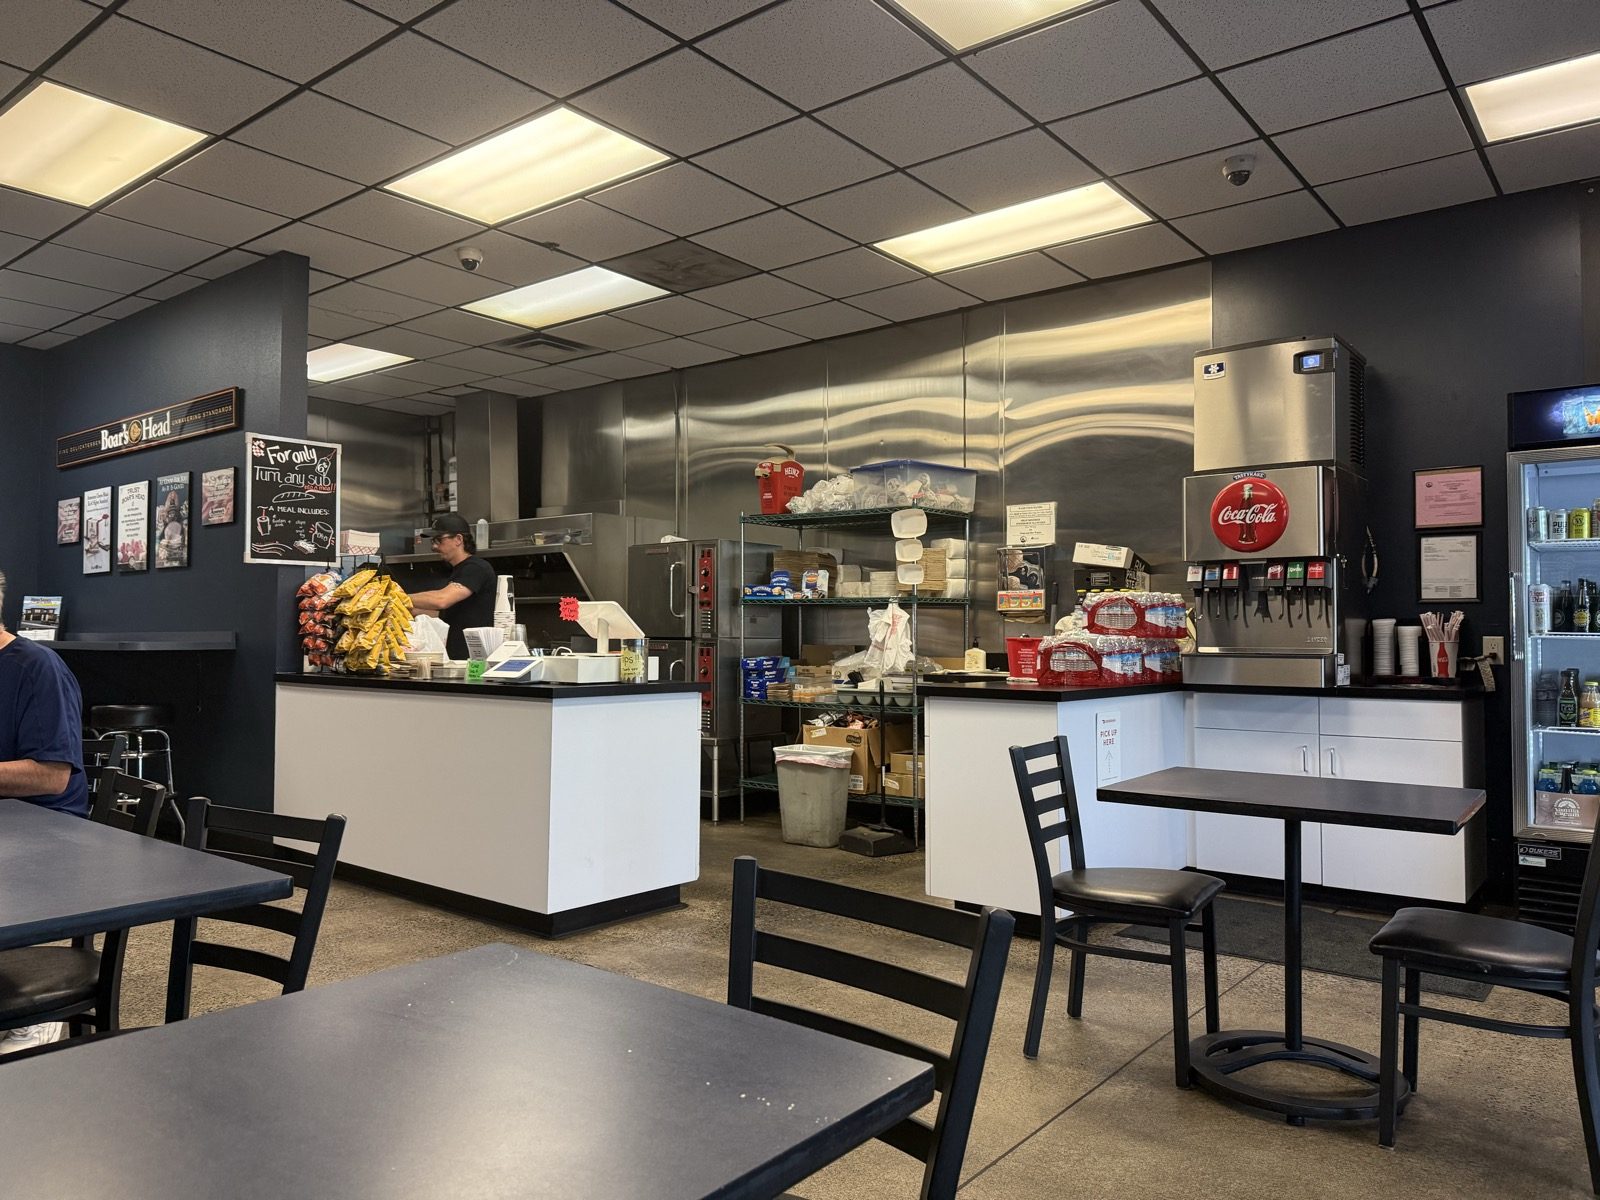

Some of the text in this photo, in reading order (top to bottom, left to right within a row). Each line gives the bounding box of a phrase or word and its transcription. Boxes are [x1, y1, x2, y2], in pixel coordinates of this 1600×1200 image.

[202, 405, 233, 419] STANDARDS
[100, 411, 172, 451] Boar's Head
[266, 445, 317, 470] For only
[784, 467, 800, 478] HEINZ
[308, 475, 332, 488] sub
[277, 506, 296, 514] MEAL
[297, 507, 330, 516] INCLUDES:
[1217, 503, 1279, 526] Coca-Cola
[1100, 729, 1110, 737] PICK
[1103, 738, 1115, 746] HERE
[1528, 847, 1559, 856] DUKERS
